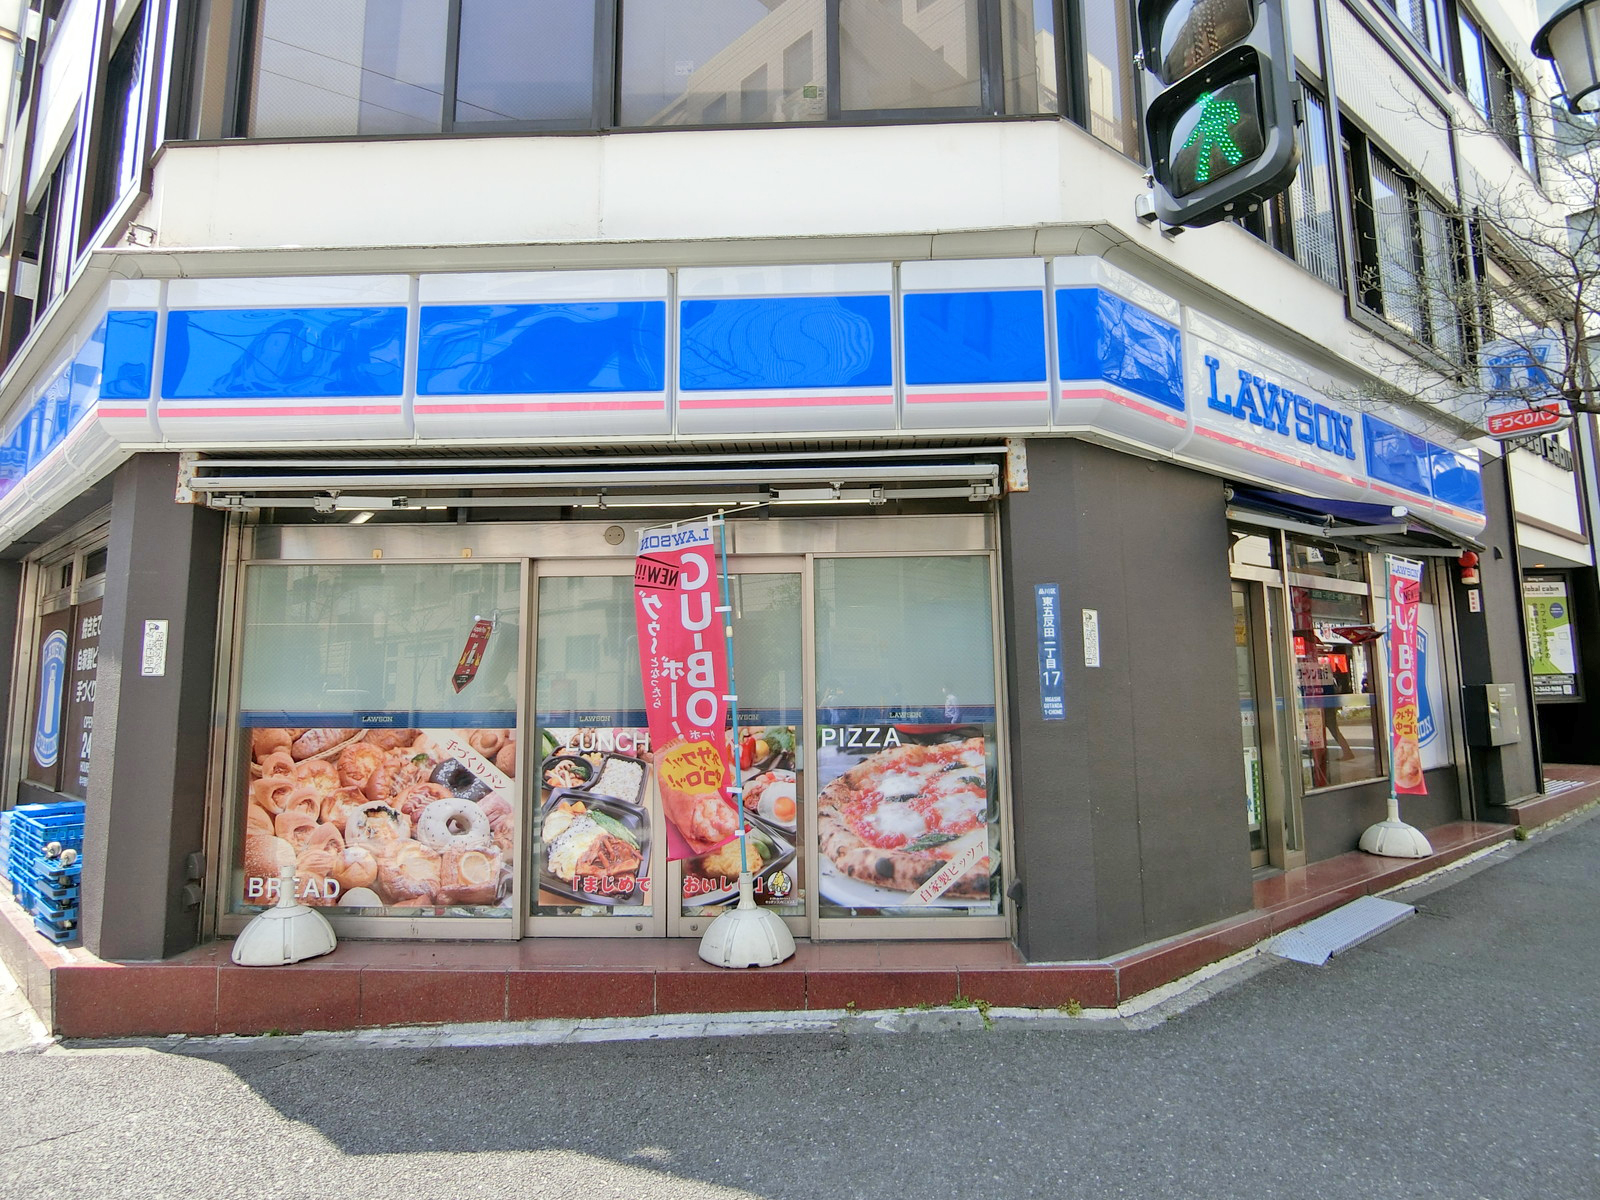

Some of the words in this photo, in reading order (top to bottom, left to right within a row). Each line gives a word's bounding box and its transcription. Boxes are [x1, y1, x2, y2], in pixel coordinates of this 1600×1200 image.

[1204, 355, 1356, 461] LAWSON
[1042, 597, 1056, 669] 東五反田一丁目
[1043, 671, 1060, 686] 17
[566, 732, 649, 752] LUNCH
[821, 727, 901, 747] PIZZA
[447, 739, 507, 790] 手づくりパン
[683, 875, 763, 894] おいし」
[919, 841, 986, 903] 自家製ピッツァ
